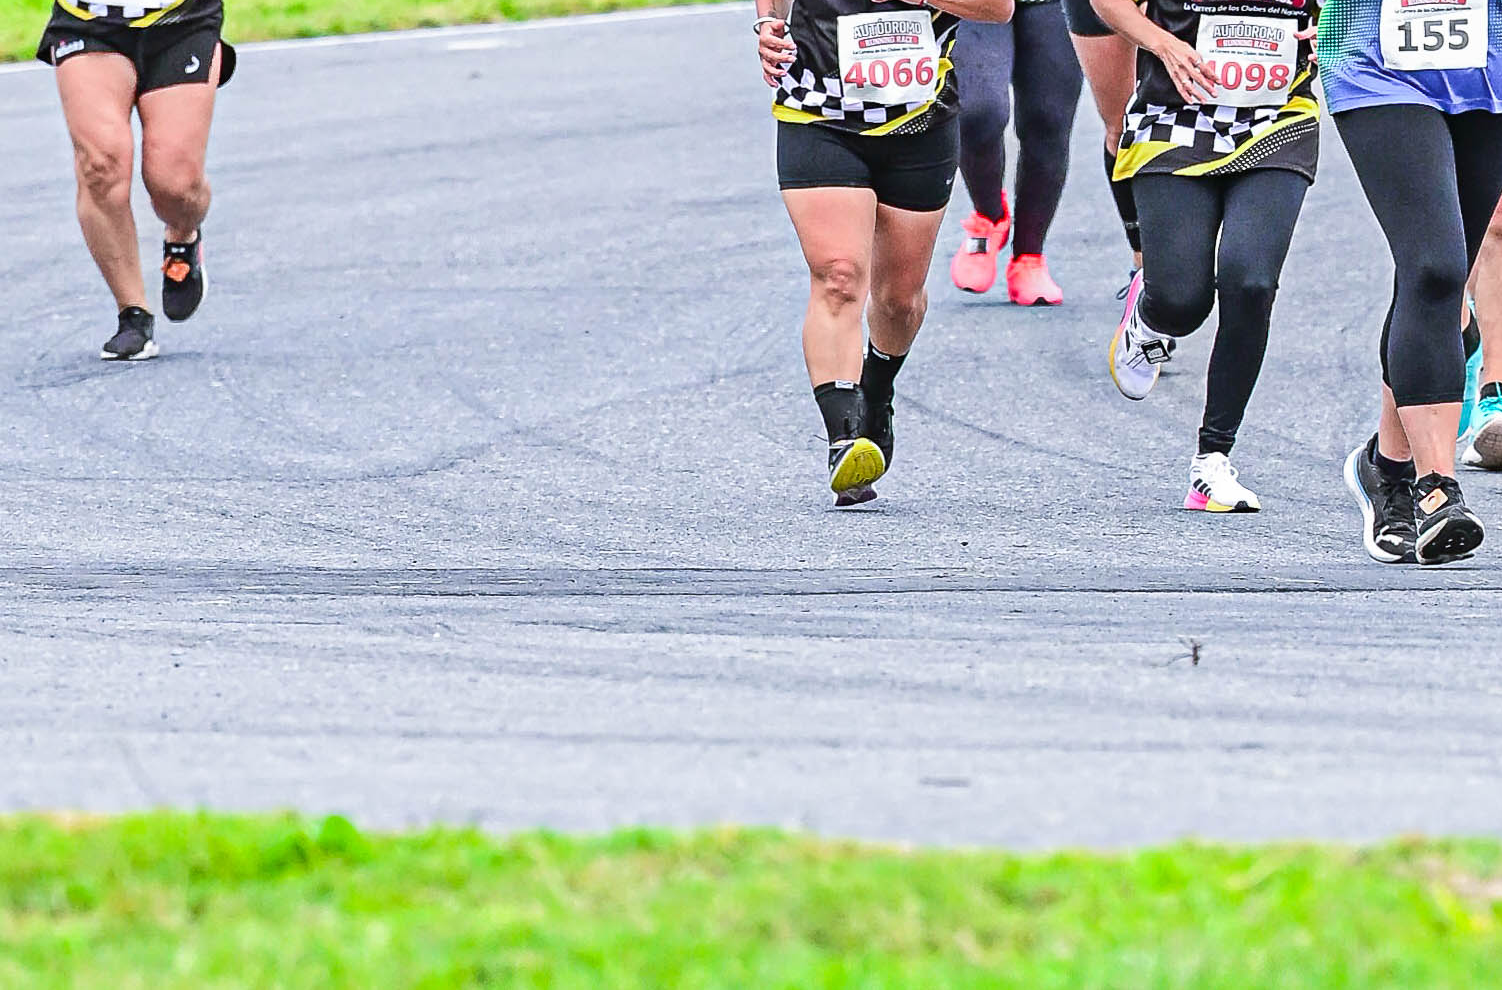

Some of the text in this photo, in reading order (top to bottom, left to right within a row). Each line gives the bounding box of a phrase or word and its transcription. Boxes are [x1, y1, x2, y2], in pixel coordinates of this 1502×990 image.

[1217, 4, 1228, 12] de
[853, 18, 923, 39] AUTÓDROMO
[1212, 21, 1285, 42] AUTÓDROMO
[1397, 19, 1470, 52] 155
[844, 57, 934, 88] 4066
